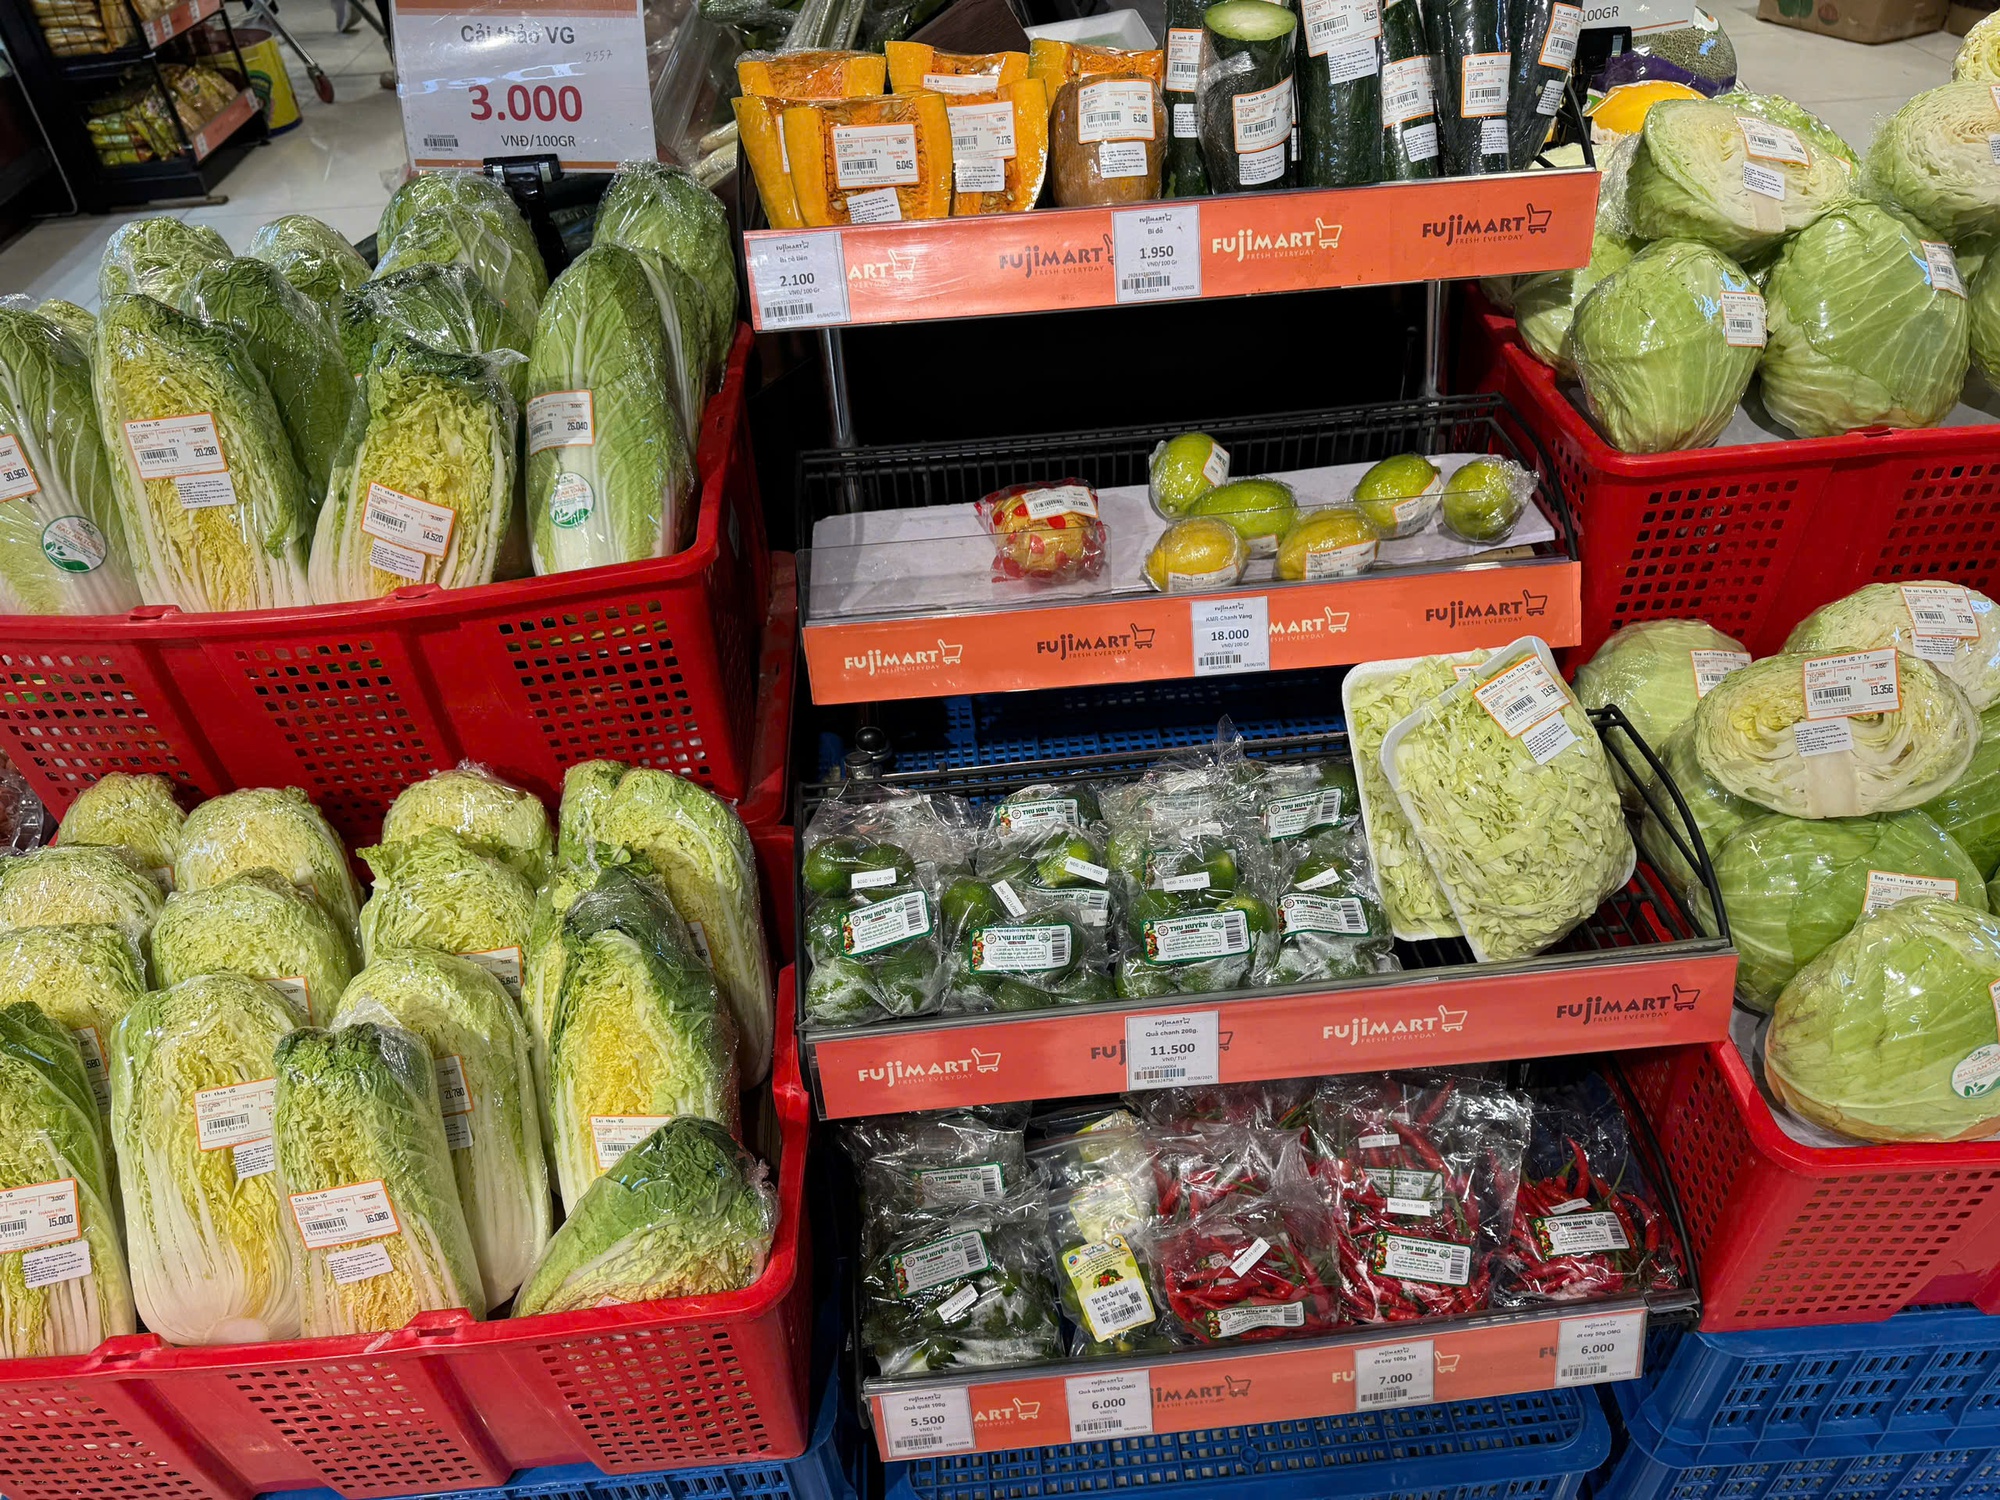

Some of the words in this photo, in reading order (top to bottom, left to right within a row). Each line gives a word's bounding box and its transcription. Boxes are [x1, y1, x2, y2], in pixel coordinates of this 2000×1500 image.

[460, 22, 492, 44] Cải
[545, 25, 576, 45] VG
[584, 50, 614, 63] 2557
[467, 84, 583, 122] 3.000
[500, 134, 577, 148] VNĐ/100GR
[895, 159, 914, 170] 6.045
[1455, 236, 1481, 245] FRESH
[1482, 232, 1526, 243] EVERYDAY
[1139, 245, 1174, 260] 1.950
[1246, 251, 1272, 260] FRESH
[1274, 247, 1317, 258] EVERYDAY
[849, 263, 890, 280] ART
[1062, 265, 1105, 276] EVERYDAY
[779, 272, 816, 288] 2.100
[566, 421, 588, 431] 26.040
[193, 445, 218, 458] 20.280
[4, 467, 29, 482] 30.960
[422, 530, 444, 544] 14.520
[1268, 617, 1325, 636] MART
[1457, 617, 1482, 626] FRESH
[1484, 614, 1524, 625] EVERYDAY
[1210, 628, 1250, 642] 18.000
[1068, 652, 1092, 660] FRESH
[1093, 649, 1132, 658] EVERYDAY
[1869, 683, 1895, 697] 13.356
[1593, 1013, 1621, 1023] FRESH
[1623, 1009, 1671, 1020] EVERYDAY
[1145, 1030, 1159, 1038] Quả
[1159, 1029, 1180, 1037] chanh
[1360, 1035, 1389, 1044] FRESH
[1391, 1030, 1438, 1041] EVERYDAY
[1150, 1042, 1196, 1056] 11.500
[48, 1213, 74, 1228] 15.000
[366, 1211, 389, 1224] 16.080
[1401, 1244, 1414, 1252] THU
[1091, 1296, 1102, 1305] Tên
[1581, 1342, 1615, 1355] 6.000
[1378, 1372, 1413, 1385] 7.000
[903, 1404, 916, 1412] Quả
[916, 1402, 931, 1410] quất
[1091, 1397, 1126, 1410] 6.000
[910, 1415, 946, 1427] 5.500
[973, 1406, 1014, 1424] ART
